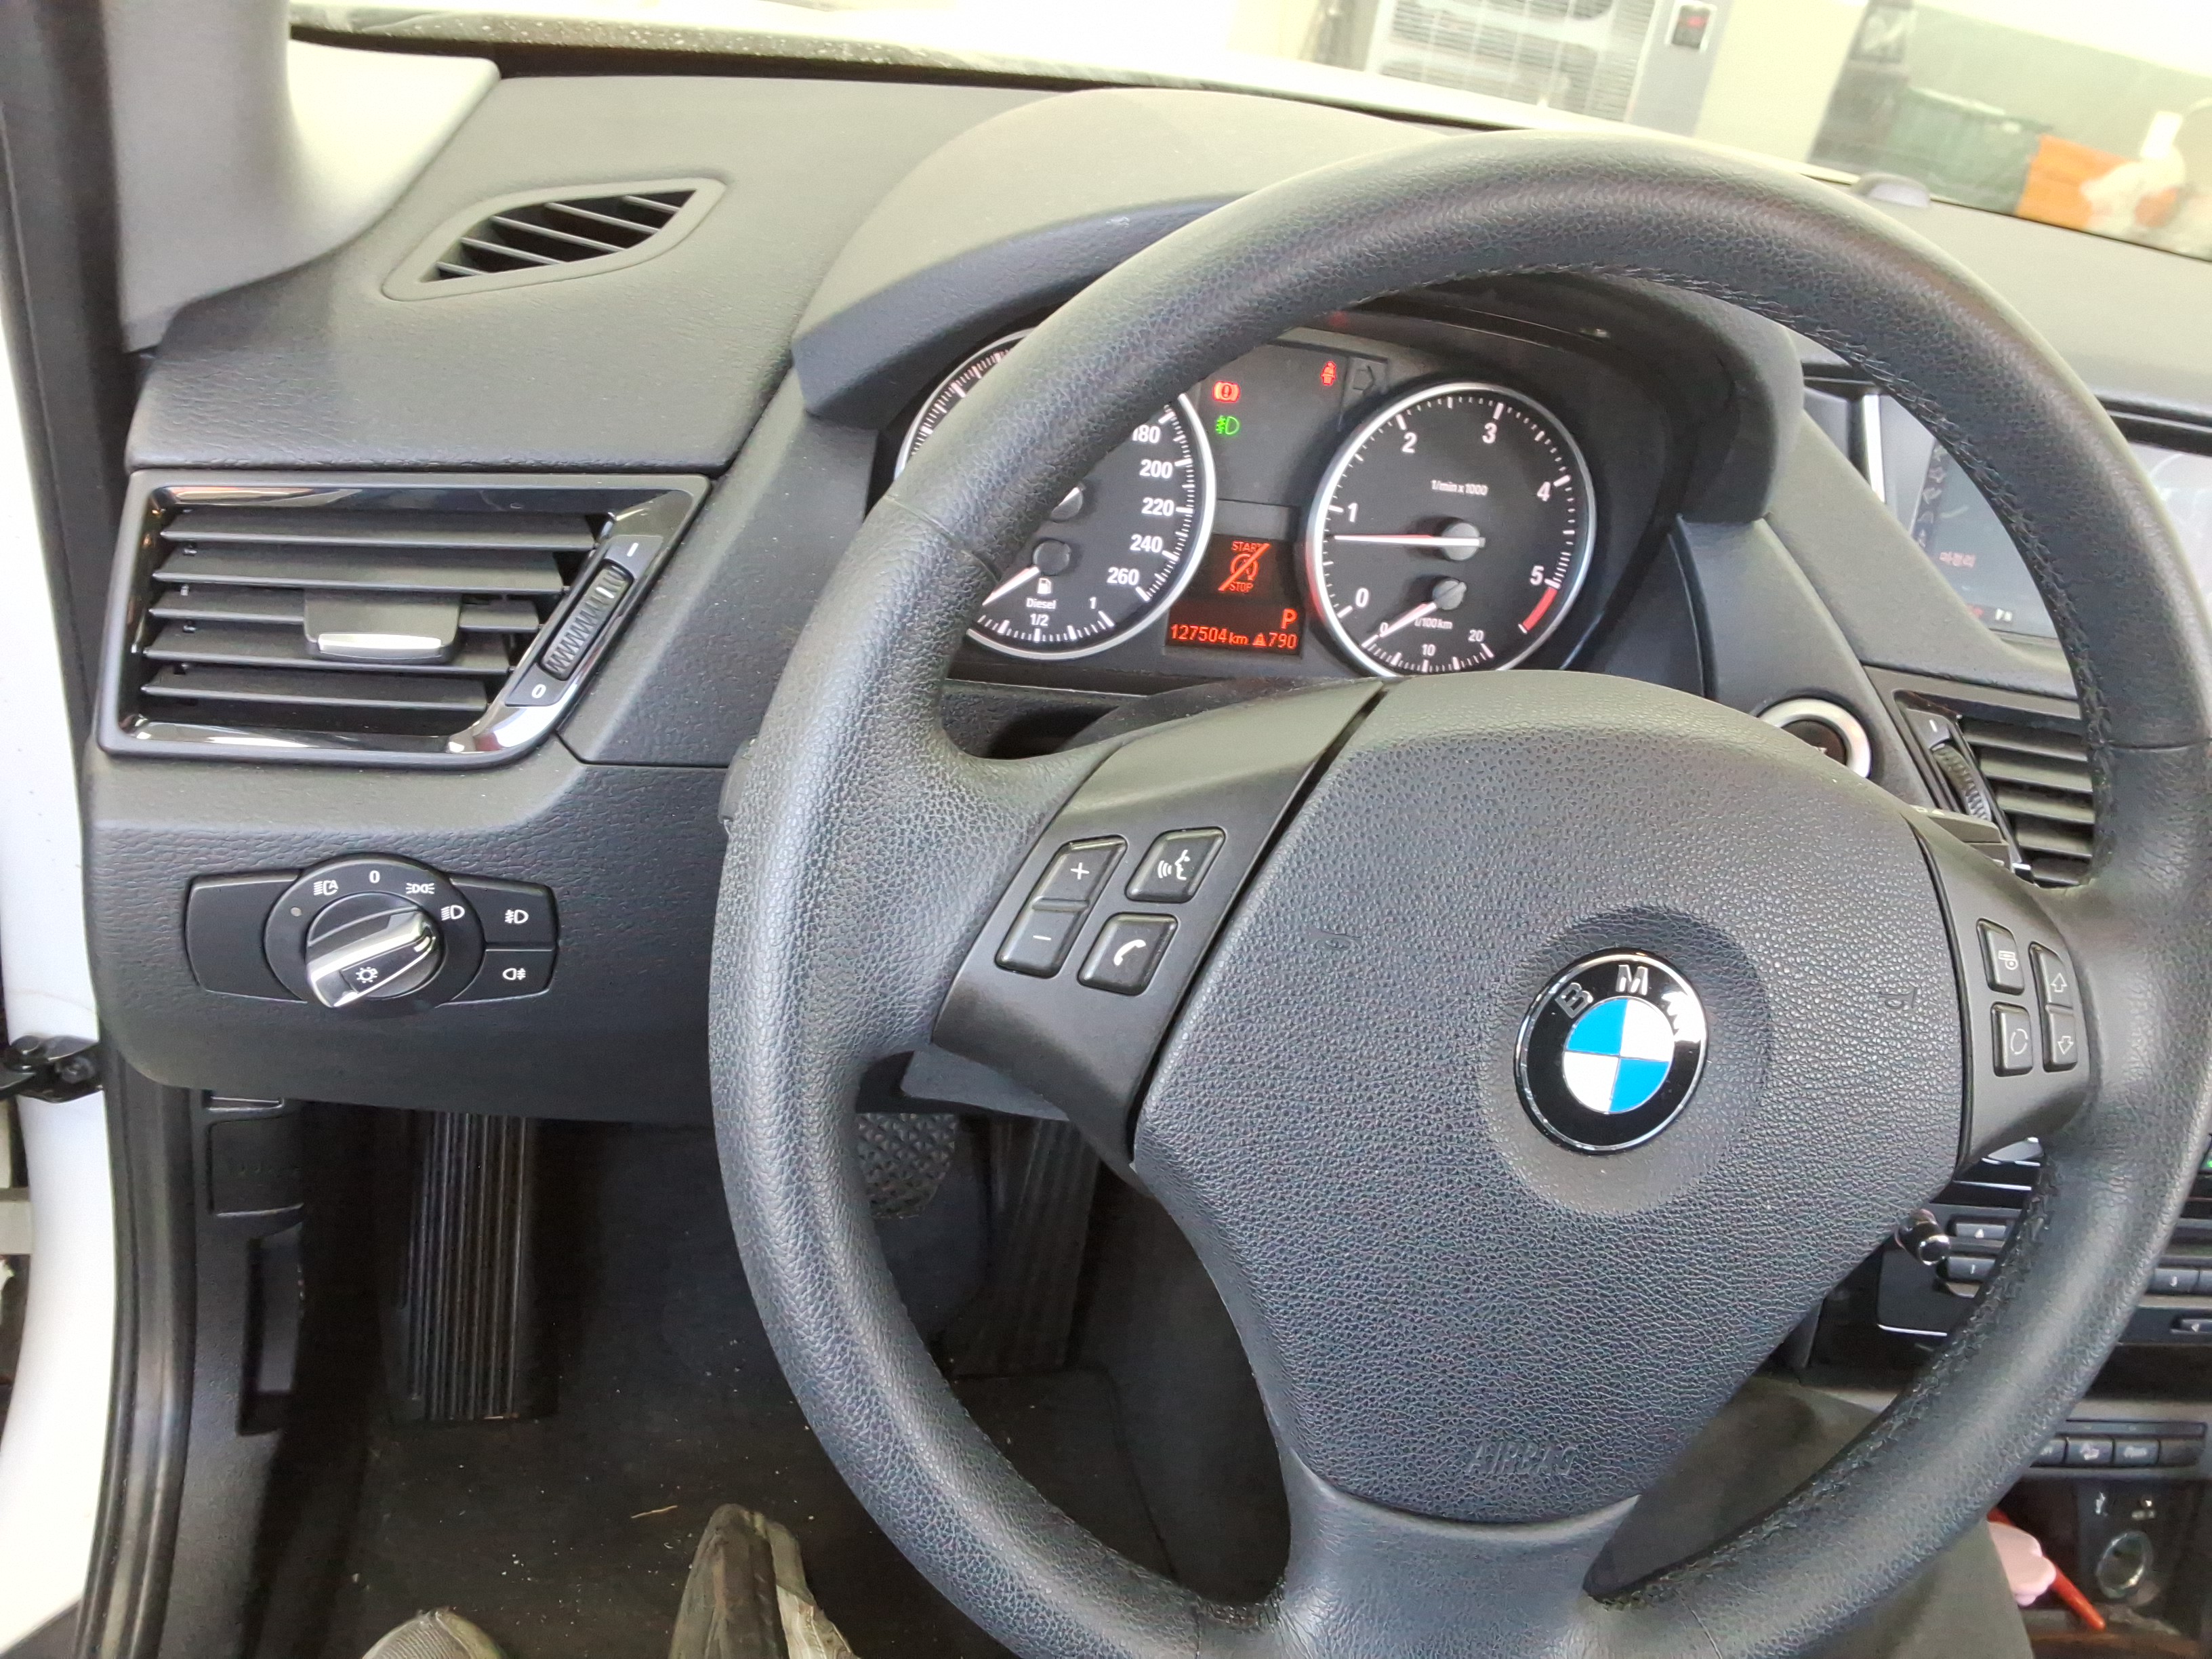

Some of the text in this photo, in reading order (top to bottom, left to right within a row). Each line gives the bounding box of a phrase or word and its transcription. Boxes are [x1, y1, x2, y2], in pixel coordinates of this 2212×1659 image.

[1132, 424, 1161, 444] 180
[1401, 432, 1418, 453] 2
[1481, 422, 1498, 444] 3
[1139, 459, 1174, 479] 200
[1465, 483, 1489, 496] 1000
[1536, 481, 1552, 502] 4
[1141, 497, 1175, 517] 220
[1347, 503, 1359, 523] 1
[1130, 534, 1164, 554] 240
[1106, 567, 1141, 586] 260
[1529, 565, 1545, 586] 5
[1229, 581, 1254, 593] STOP
[1025, 597, 1058, 610] Diesel
[1089, 596, 1097, 610] 1
[1355, 588, 1370, 609] 0
[1029, 613, 1050, 627] 1/2
[1280, 608, 1298, 630] P
[1269, 632, 1298, 650] 790
[1468, 629, 1485, 642] 20
[1422, 644, 1436, 657] 10
[368, 869, 381, 884] 0
